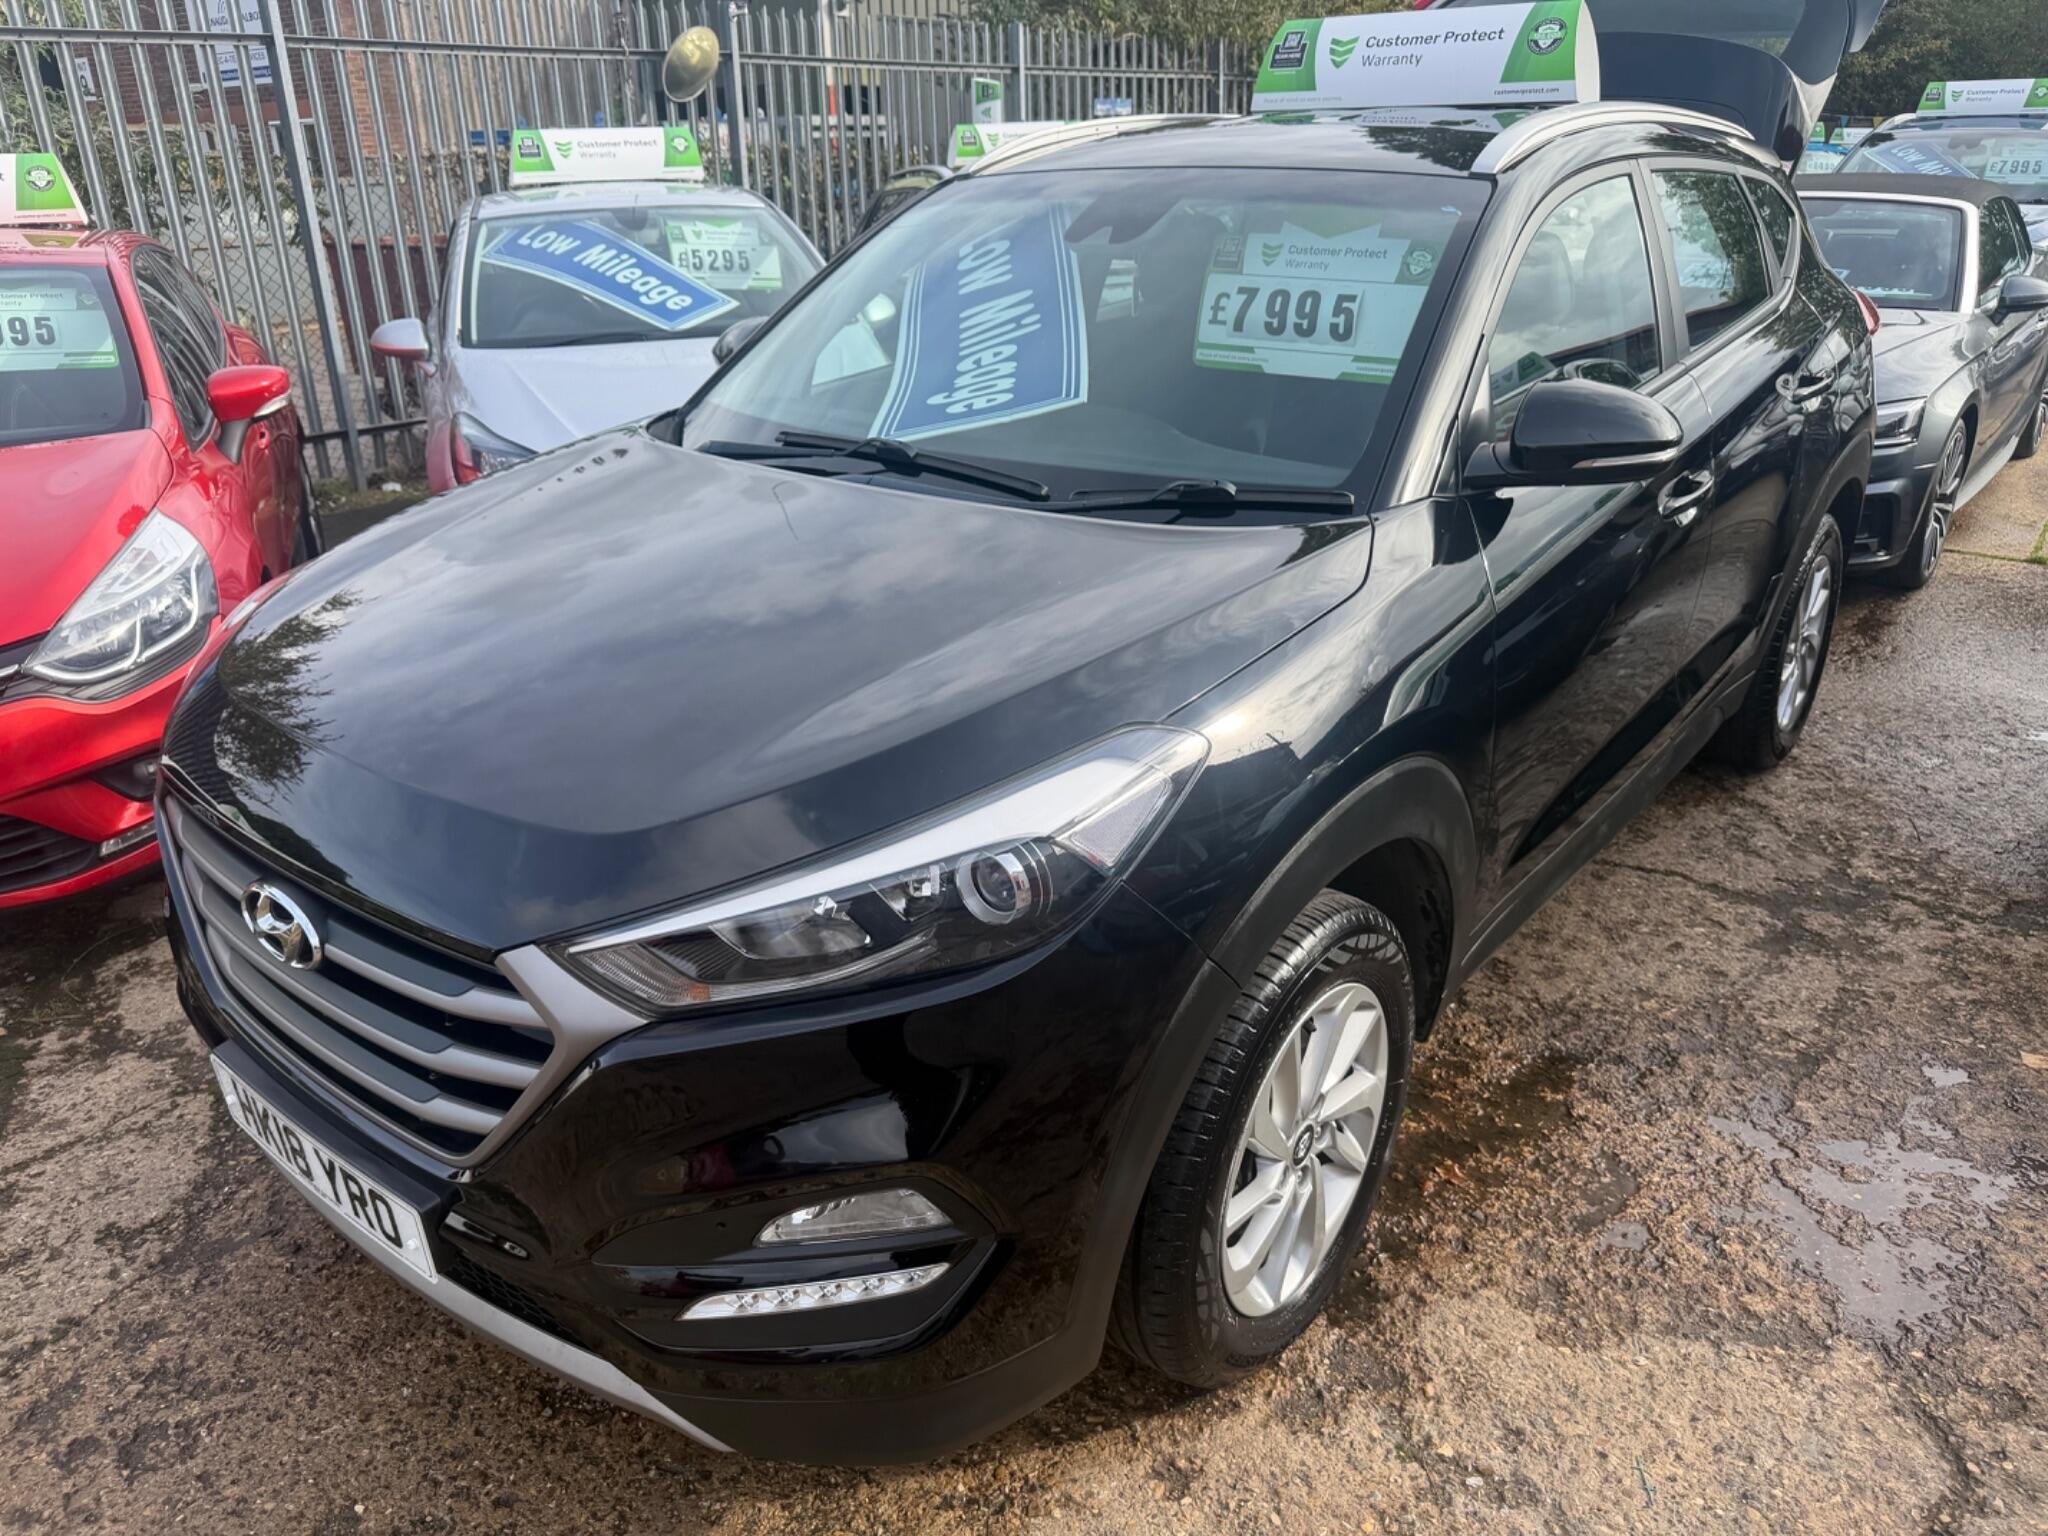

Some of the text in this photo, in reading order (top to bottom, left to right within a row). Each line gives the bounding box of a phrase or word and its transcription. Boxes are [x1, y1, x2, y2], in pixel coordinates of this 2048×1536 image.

[1365, 26, 1505, 48] Customer Protect
[1361, 52, 1423, 68] Warranty
[577, 138, 657, 149] Customer Protect
[1991, 160, 2043, 174] £7995
[679, 249, 750, 272] £5295
[1288, 244, 1388, 260] Customer Protect
[1285, 259, 1330, 273] Warranty
[573, 244, 692, 311] Mileage
[1208, 286, 1358, 342] £7995
[926, 289, 1042, 413] Mileage
[231, 1078, 403, 1249] HK18 YRO
